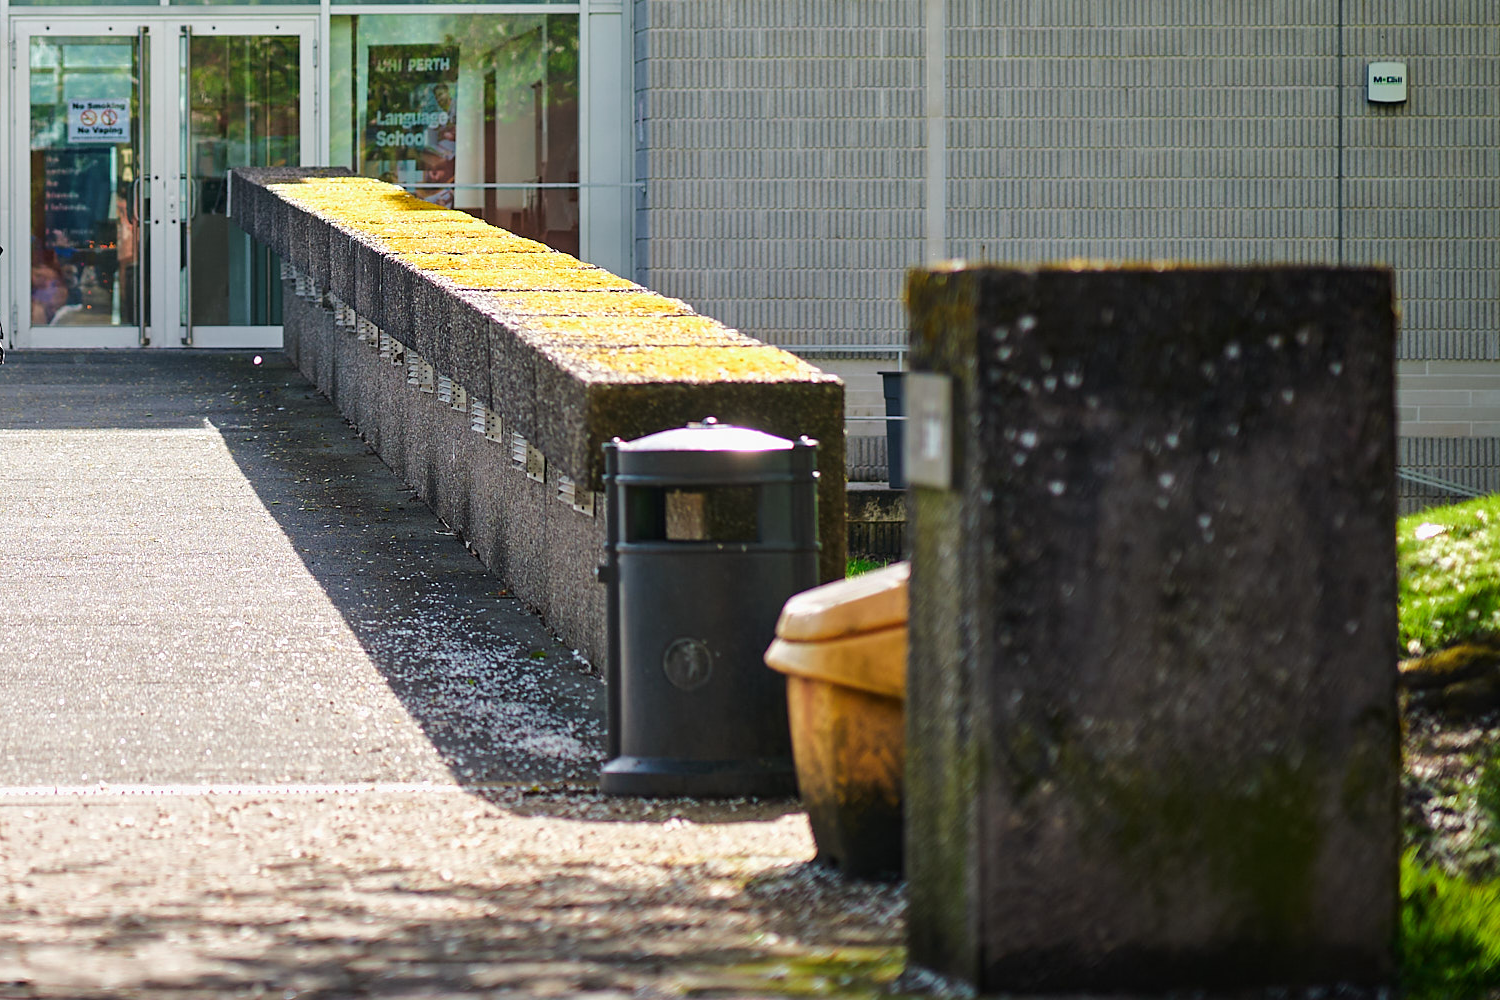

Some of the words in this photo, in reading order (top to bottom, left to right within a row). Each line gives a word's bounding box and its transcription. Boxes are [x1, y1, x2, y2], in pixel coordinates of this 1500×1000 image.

[408, 57, 450, 72] PERTH
[377, 111, 449, 129] Language
[376, 131, 428, 147] School
